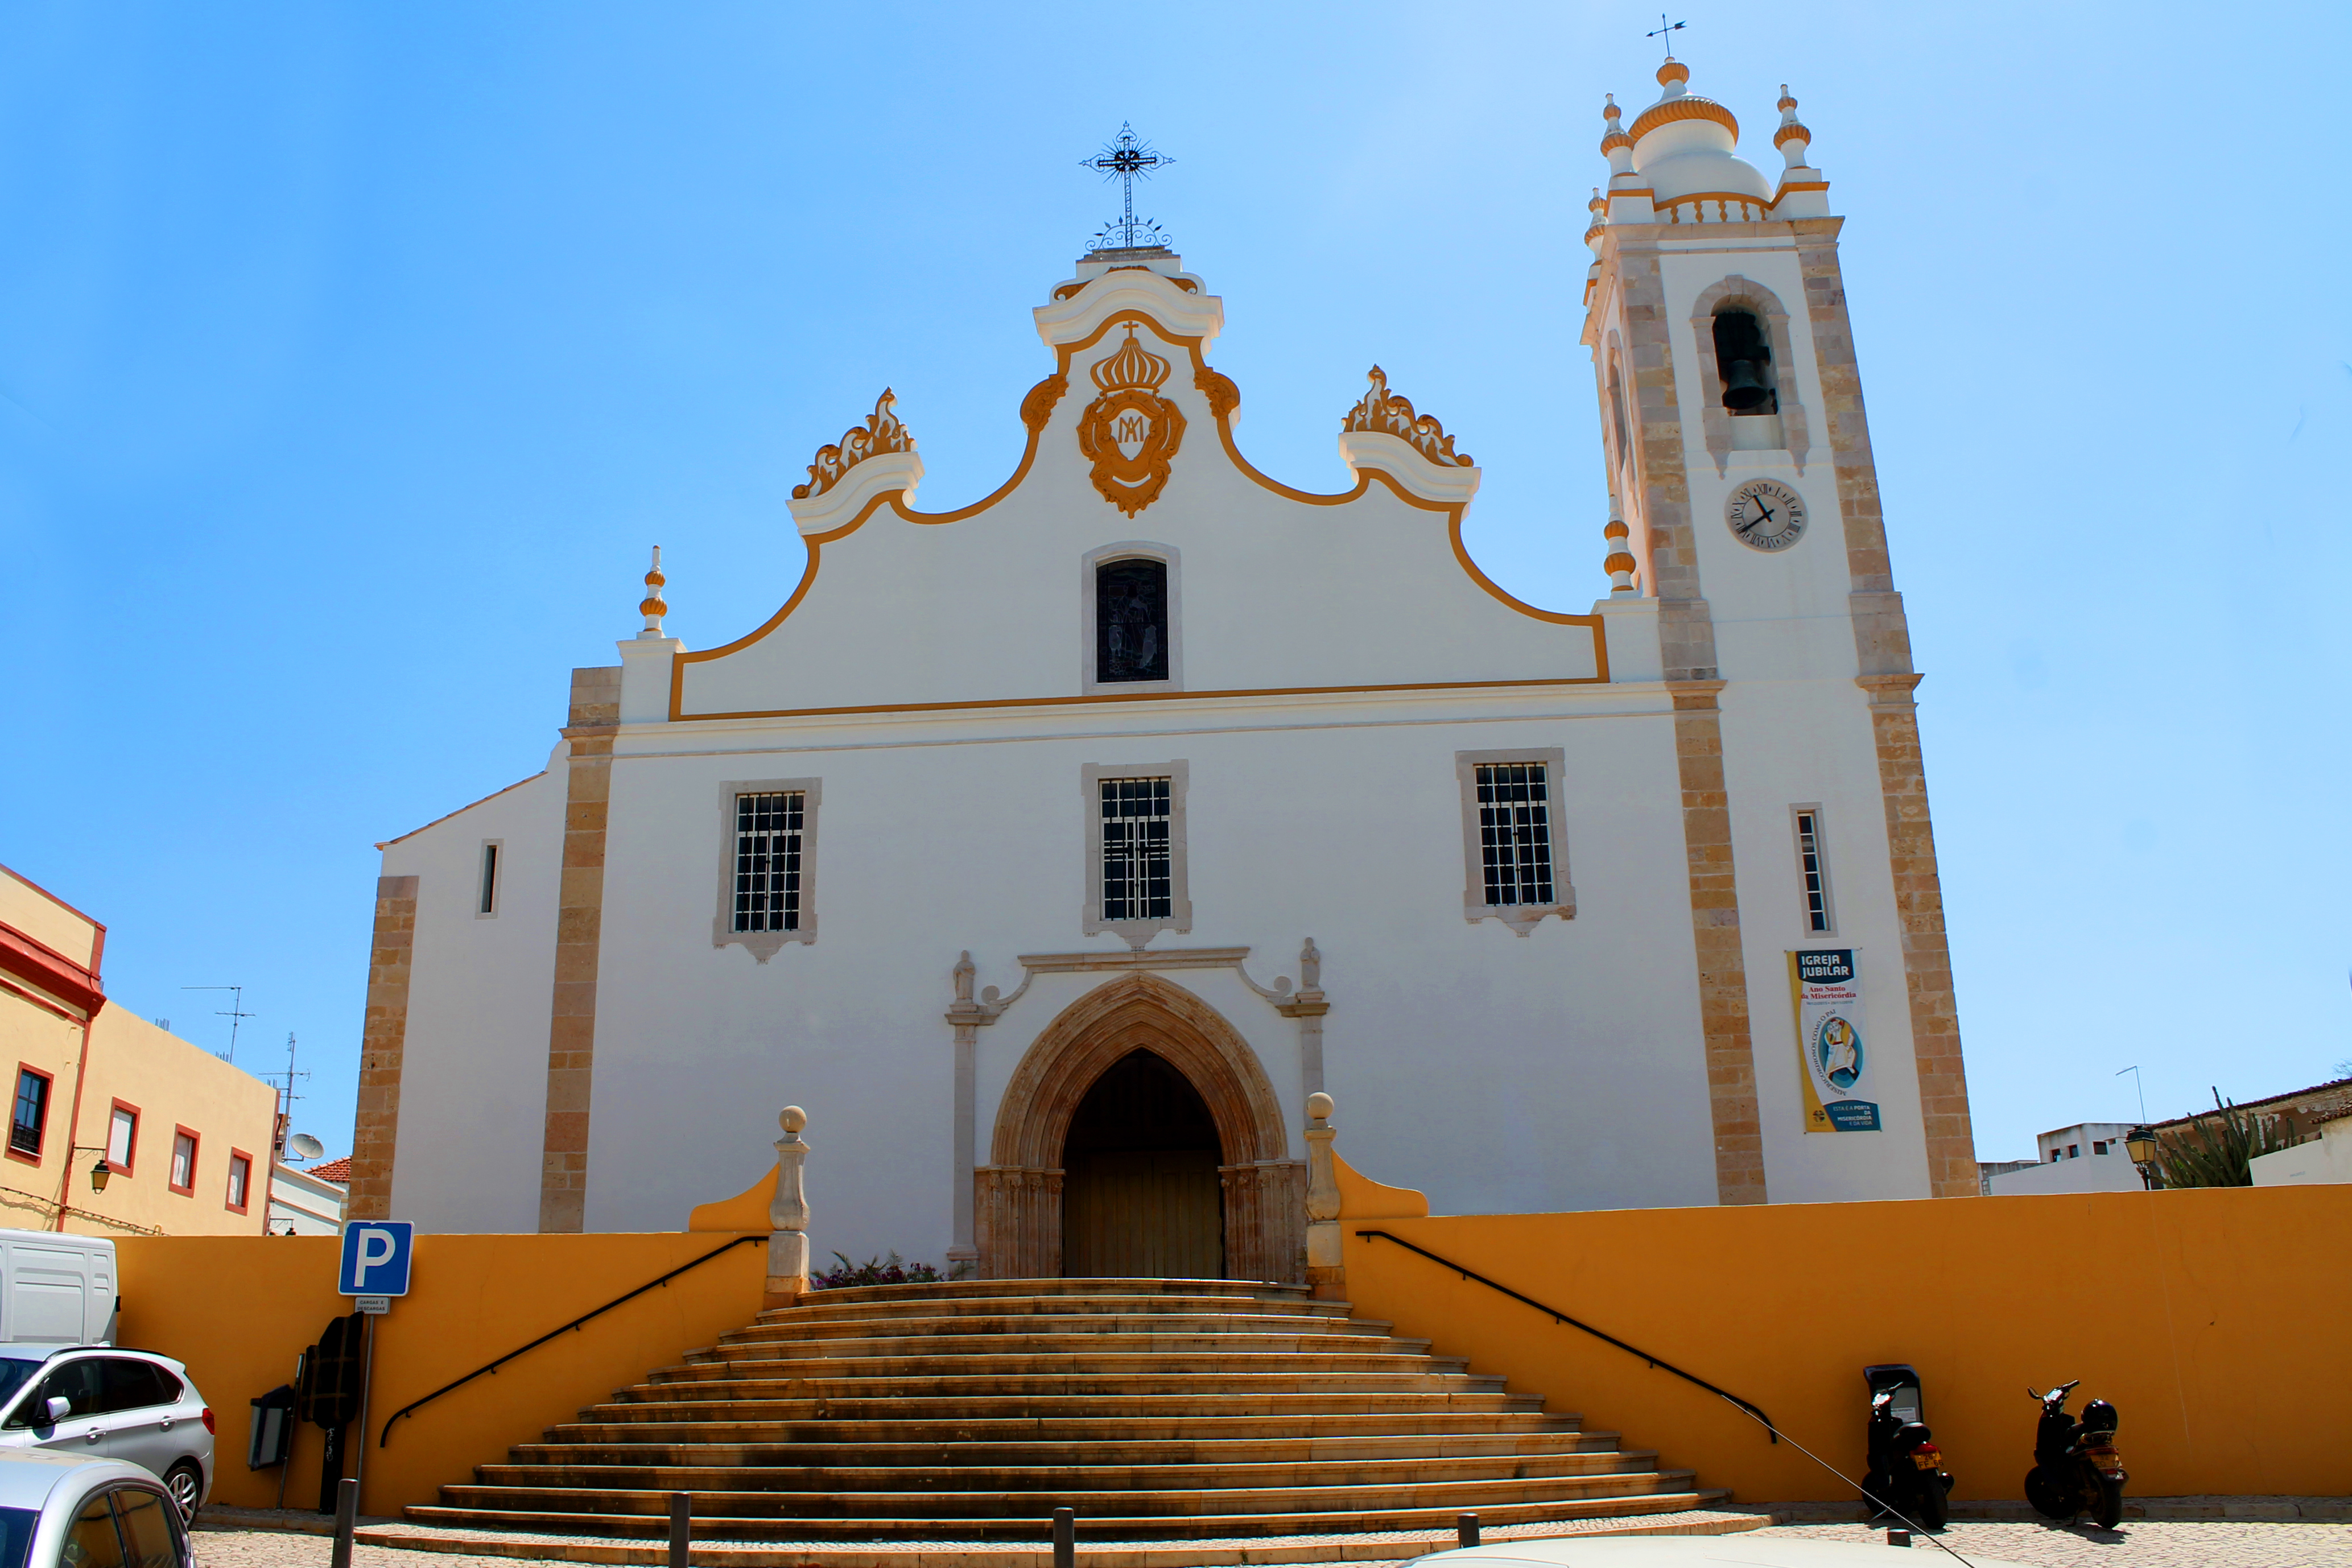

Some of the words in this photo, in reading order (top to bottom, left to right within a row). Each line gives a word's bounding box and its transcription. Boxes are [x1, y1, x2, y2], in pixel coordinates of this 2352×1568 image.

[1801, 955, 1840, 966] IGREJA
[1802, 966, 1849, 979] JUBILAR
[354, 1229, 395, 1287] P
